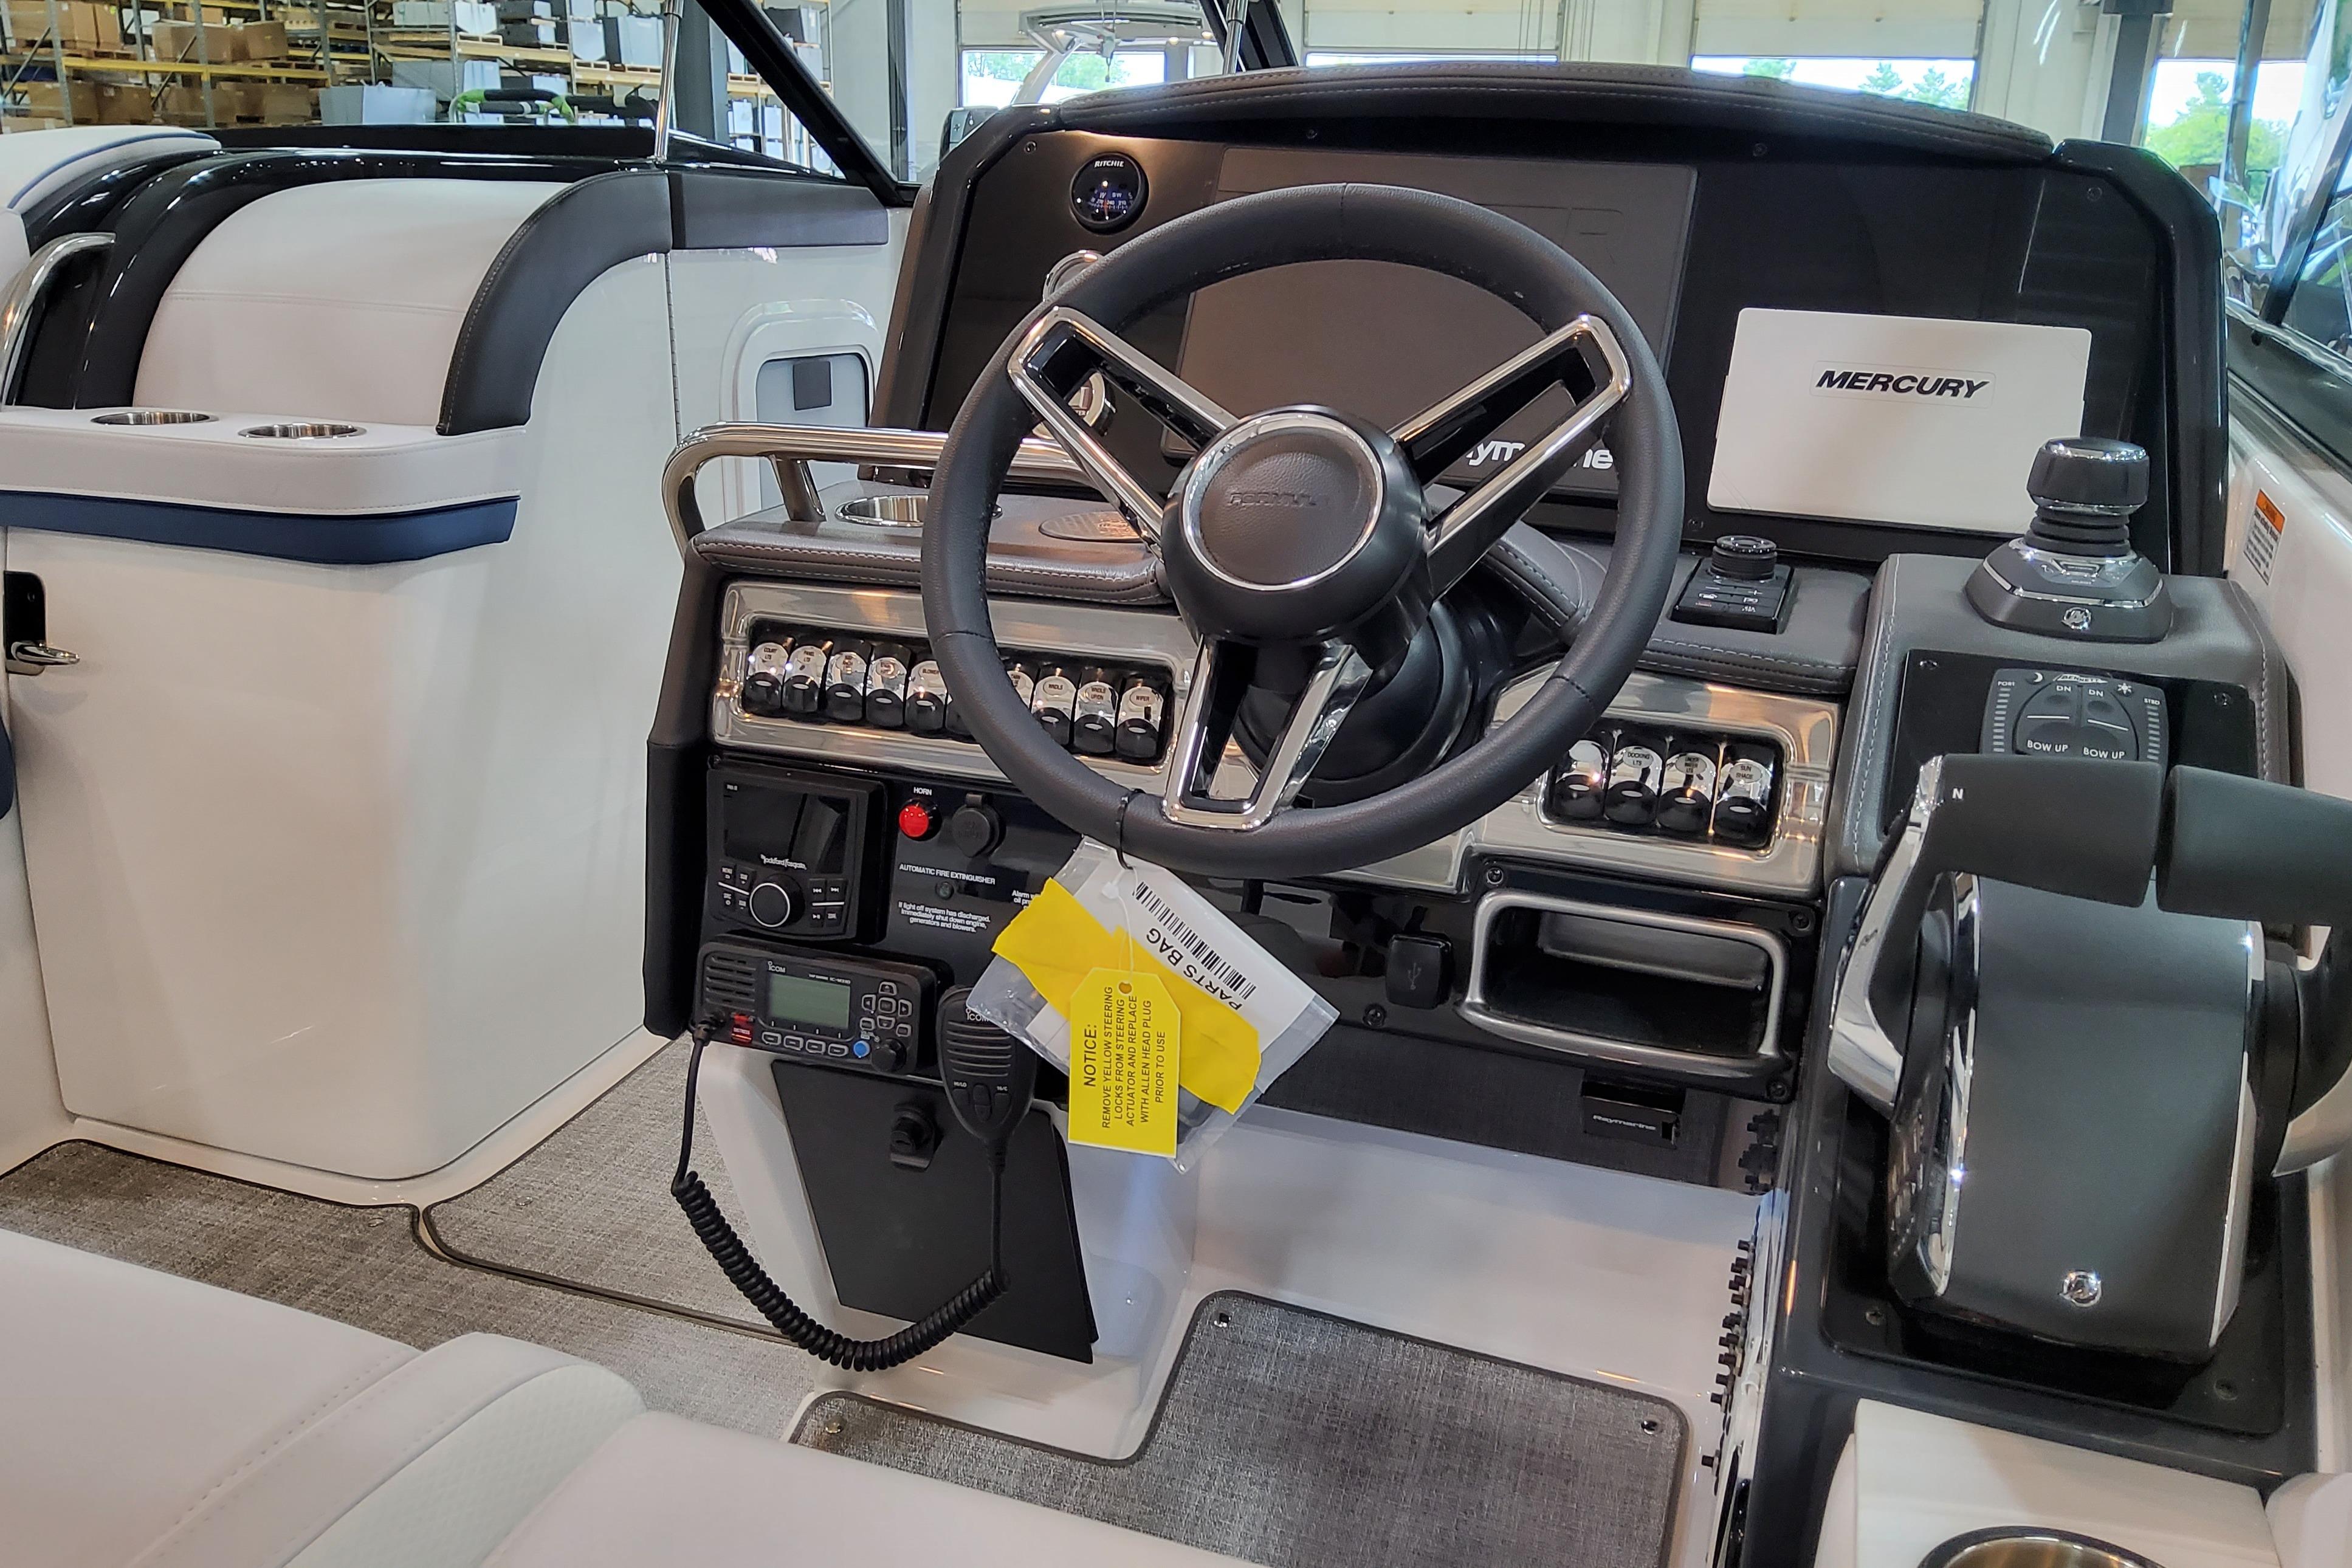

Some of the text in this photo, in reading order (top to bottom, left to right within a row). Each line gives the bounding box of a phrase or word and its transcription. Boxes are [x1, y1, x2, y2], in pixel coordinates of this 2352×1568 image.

[1815, 370, 1990, 399] MERCURY
[2088, 689, 2103, 697] DN
[2027, 740, 2068, 752] BOW UP
[2083, 747, 2108, 758] BOW
[913, 786, 932, 796] HORN
[1952, 788, 1964, 799] N
[899, 864, 995, 885] AUTOMATIC FIRE EXTINGUISHER
[1011, 889, 1030, 899] Alarm
[903, 902, 916, 910] light
[924, 906, 946, 915] system
[946, 909, 957, 917] has
[909, 916, 940, 927] generators
[1146, 927, 1243, 1011] PARTS BAG
[1084, 1024, 1097, 1087] NOTICE:
[1102, 986, 1113, 1129] REMOVE YELLOW STEERING
[1114, 999, 1125, 1119] LOCKS FROM STEERING
[1126, 995, 1137, 1127] ACTUATOR AND REPLACE
[1140, 1000, 1152, 1123] WITH ALLEN HEAD PLUG
[1155, 1031, 1166, 1103] PRIOR TO USE
[1593, 1115, 1656, 1130] Raymarine
